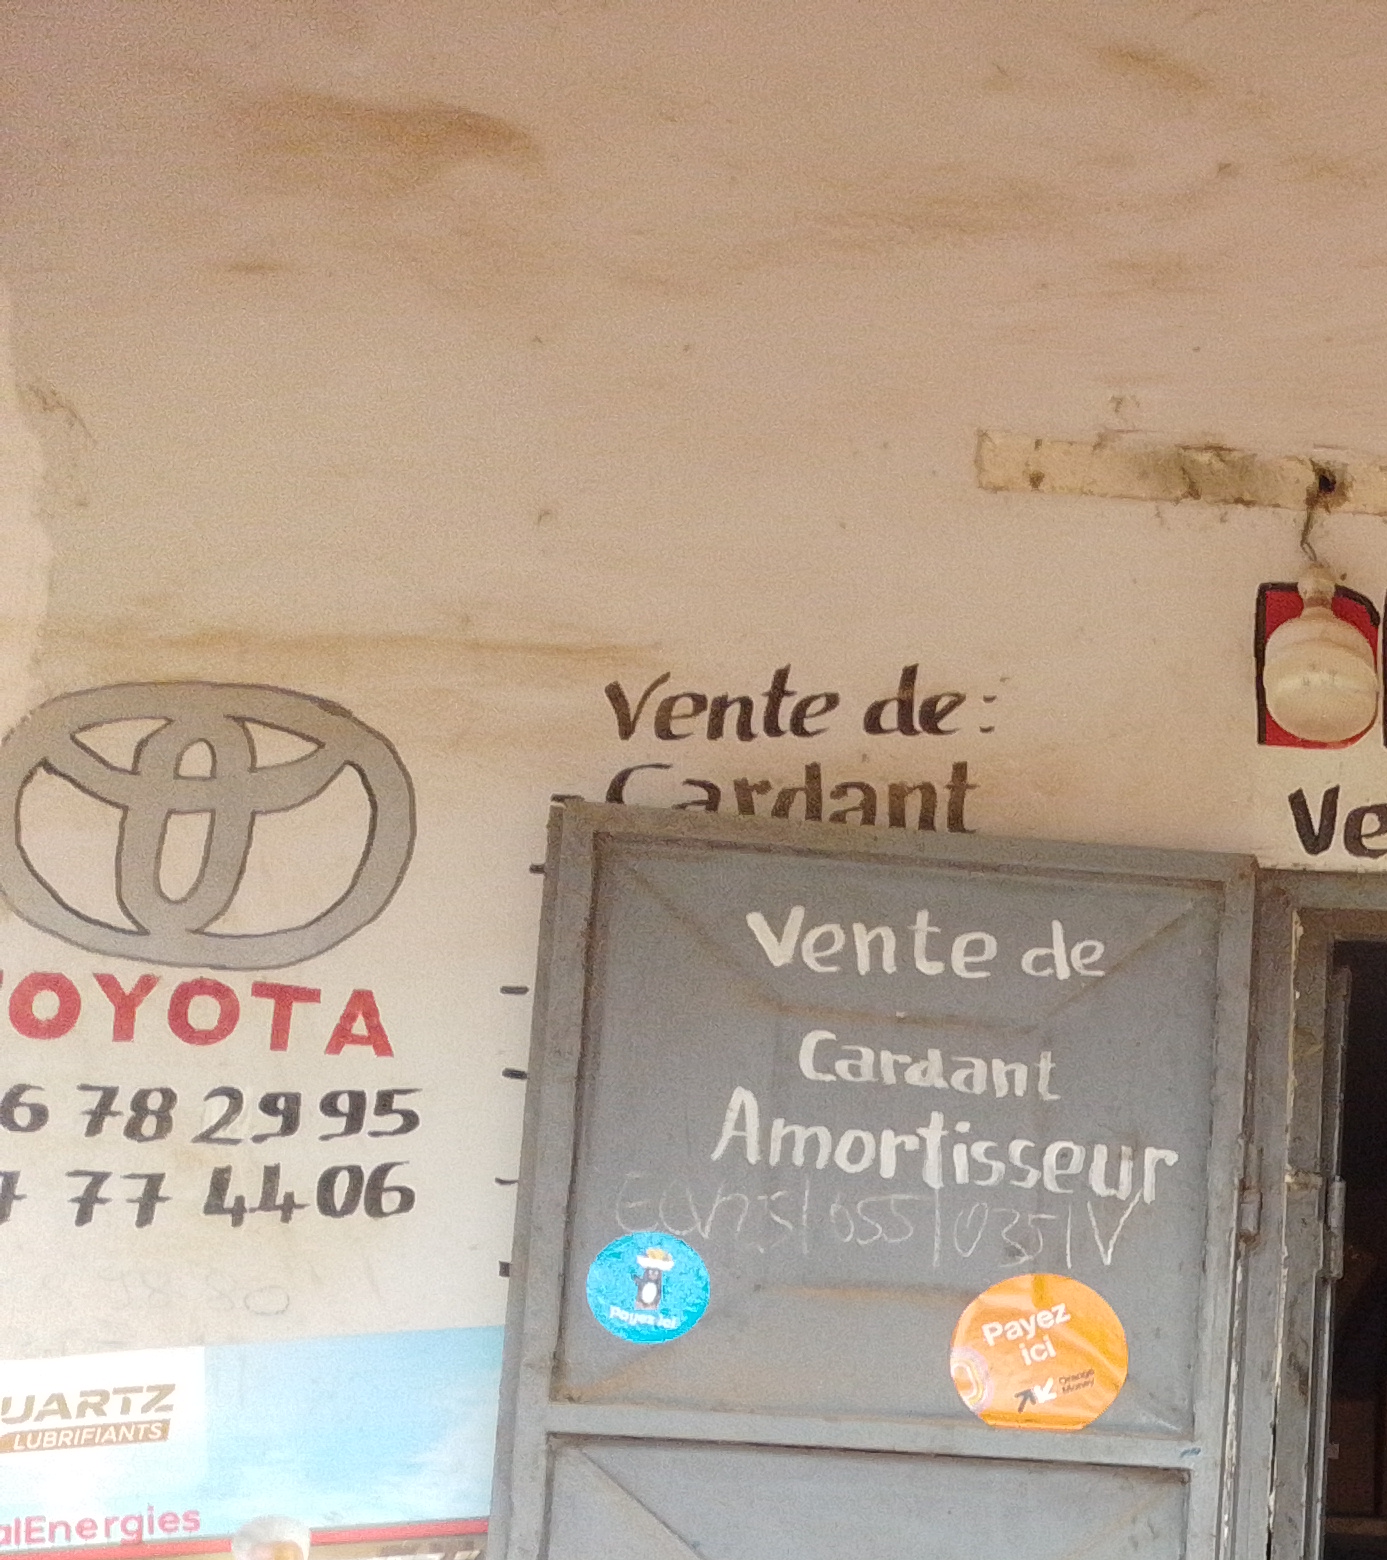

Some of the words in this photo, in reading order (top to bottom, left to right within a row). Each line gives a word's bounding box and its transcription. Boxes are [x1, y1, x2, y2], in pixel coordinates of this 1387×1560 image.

[605, 663, 841, 742] Vente
[605, 761, 980, 834] Cardant
[746, 905, 998, 979] Vente
[1020, 920, 1107, 981] de
[0, 971, 395, 1058] OYOTA
[799, 1029, 1061, 1101] Cardant
[76, 1083, 178, 1143] 78
[710, 1086, 1180, 1204] Amortisseur
[65, 1169, 173, 1229] 77
[981, 1302, 1071, 1347] Payez
[1019, 1335, 1057, 1366] ici
[13, 1422, 163, 1451] LUBRIFIANTS
